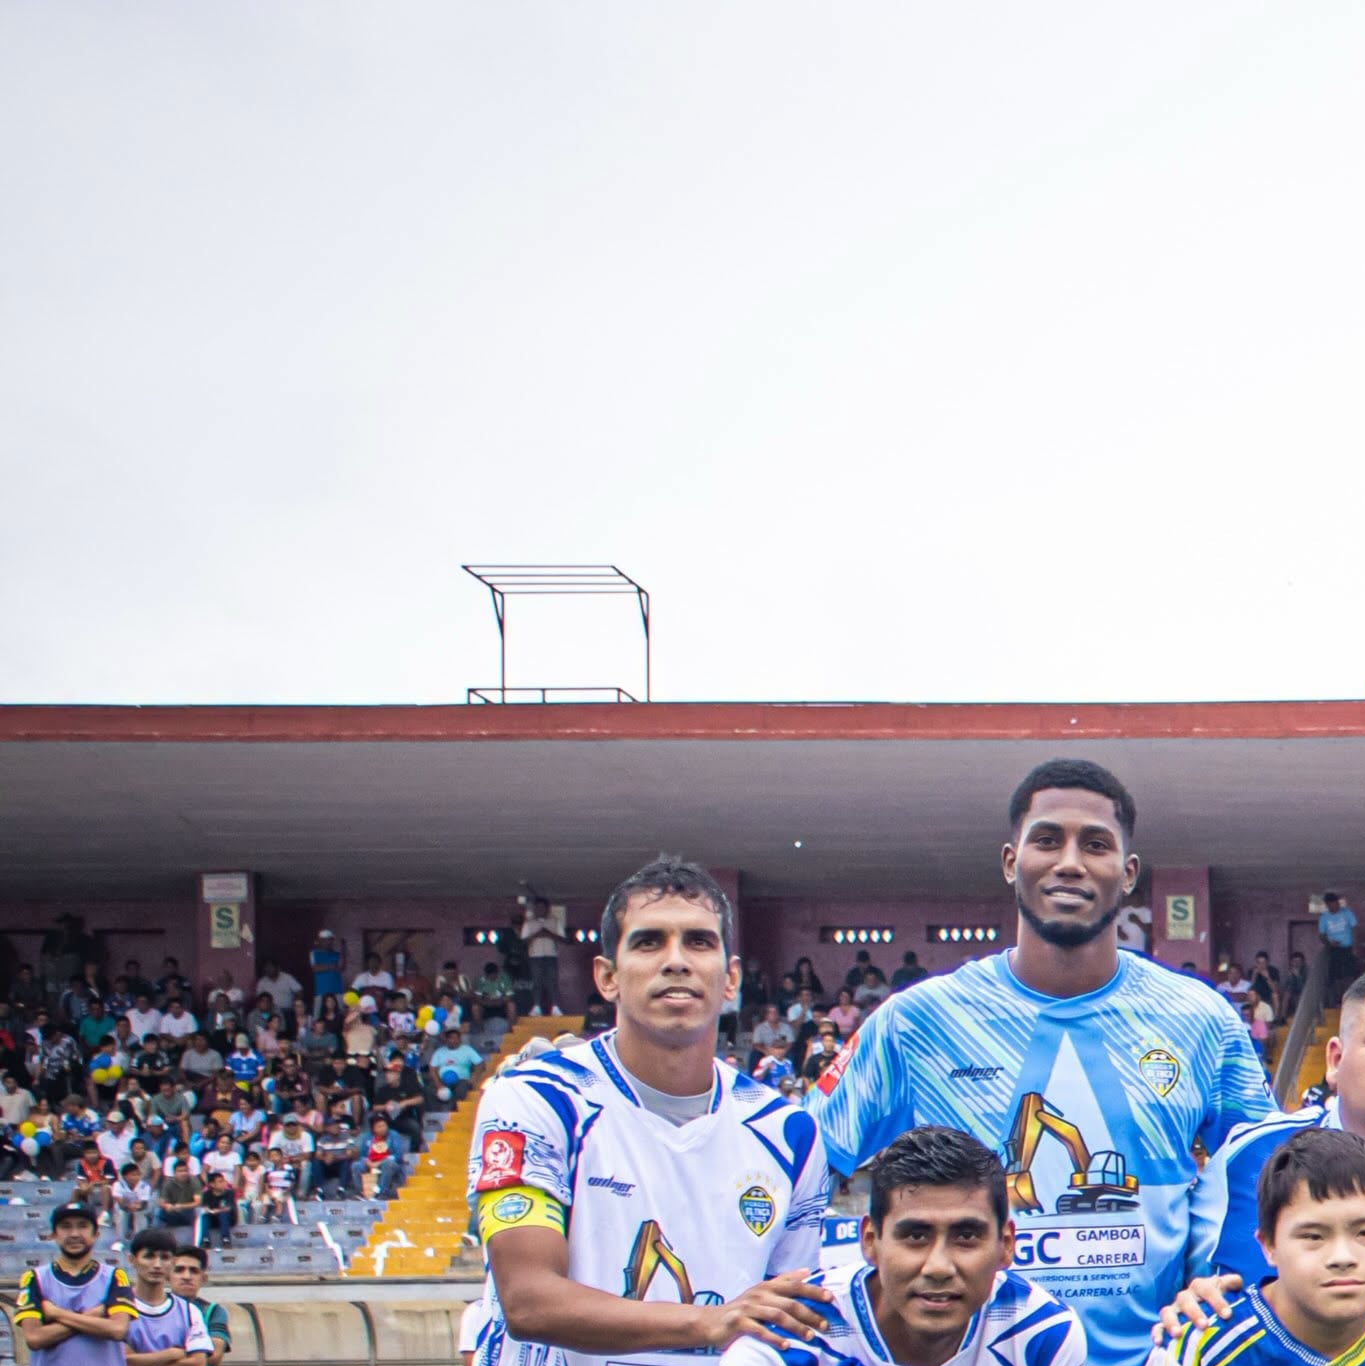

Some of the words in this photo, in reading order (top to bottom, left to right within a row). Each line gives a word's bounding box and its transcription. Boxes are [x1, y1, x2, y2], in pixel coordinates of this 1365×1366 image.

[215, 907, 234, 929] S
[1171, 898, 1190, 921] S
[836, 1221, 858, 1240] DE
[1076, 1228, 1141, 1242] GAMBOA
[1013, 1232, 1062, 1265] GC
[1077, 1253, 1138, 1265] CARRERA
[1064, 1287, 1115, 1298] CARRERA
